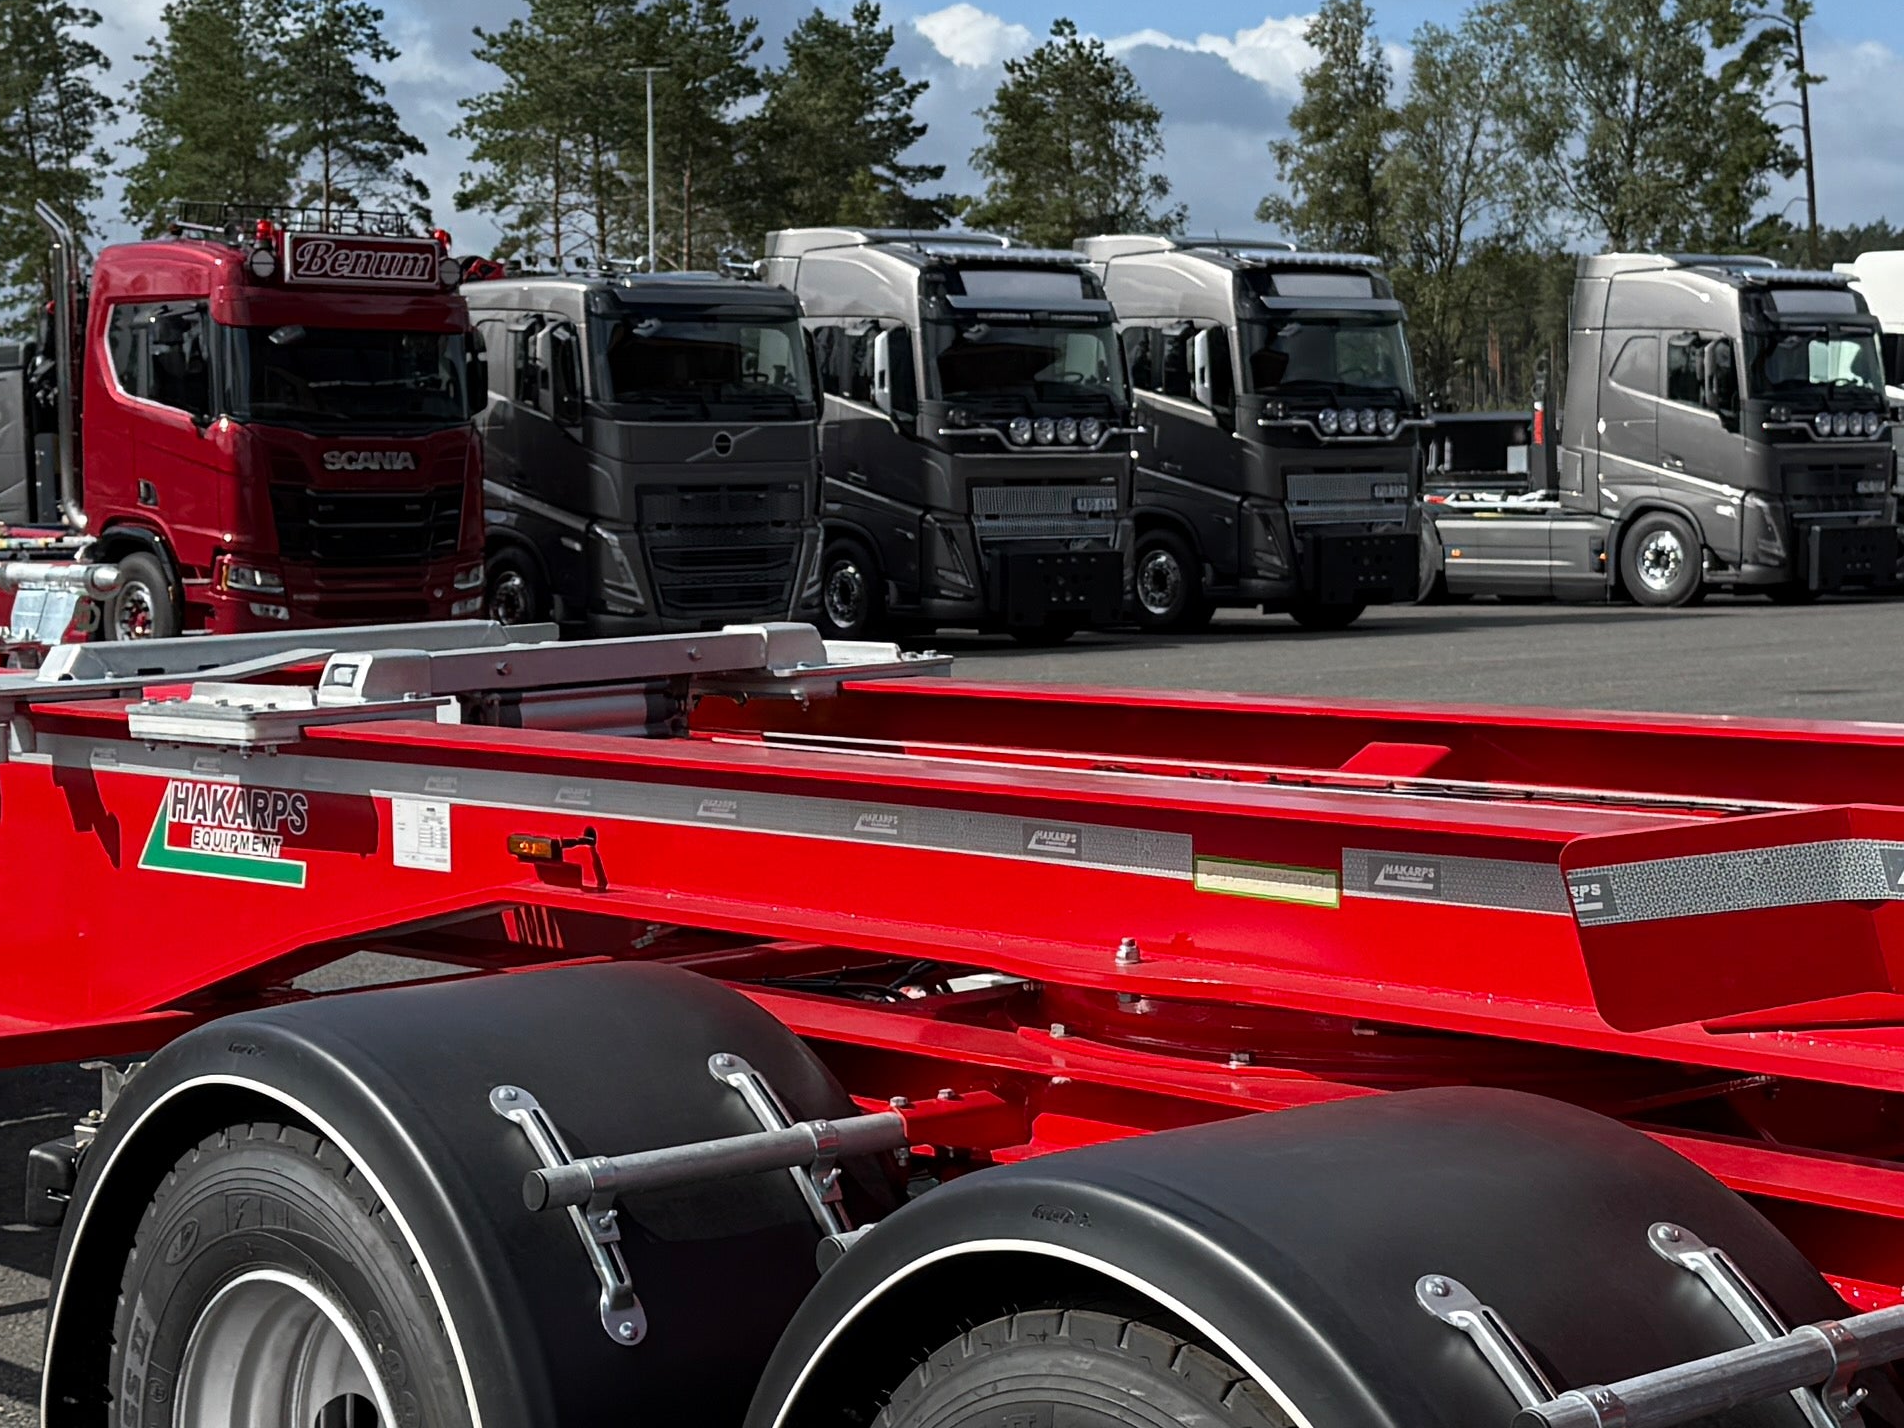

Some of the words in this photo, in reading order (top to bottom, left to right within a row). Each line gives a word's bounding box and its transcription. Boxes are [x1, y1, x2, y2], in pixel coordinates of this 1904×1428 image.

[296, 240, 433, 280] Benum
[323, 451, 416, 470] SCANIA
[170, 780, 309, 835] HAKARPS
[191, 826, 282, 858] EQUIPMENT
[1385, 863, 1435, 878] HAKARPS
